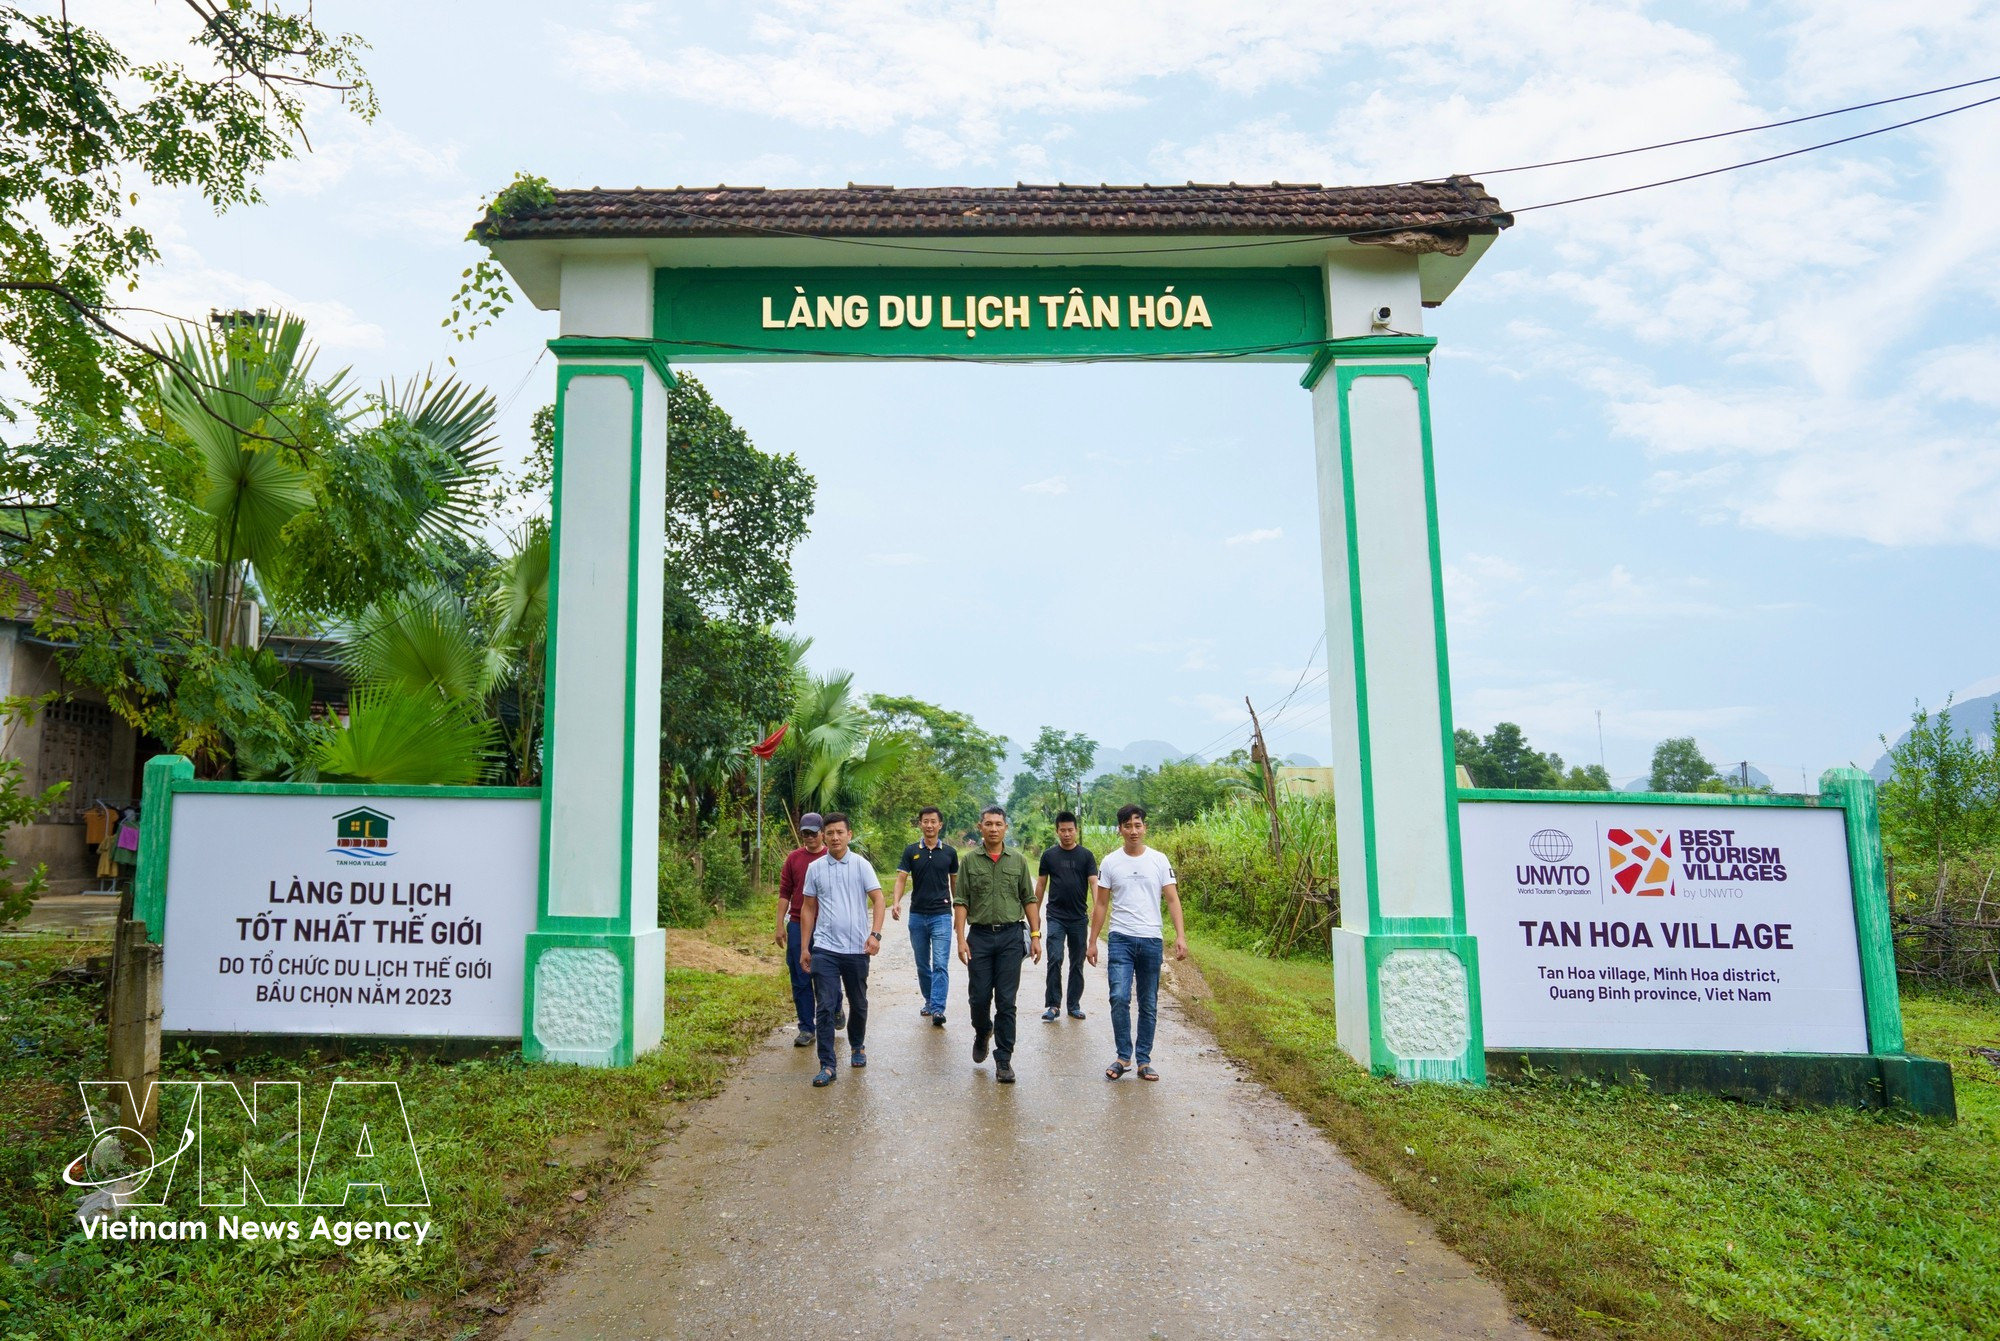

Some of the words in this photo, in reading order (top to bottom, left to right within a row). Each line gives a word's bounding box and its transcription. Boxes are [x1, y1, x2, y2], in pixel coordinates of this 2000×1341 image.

[761, 286, 869, 329] LÀNG
[879, 295, 933, 329] DU
[941, 295, 1031, 338] LỊCH
[1038, 287, 1120, 329] TÂN
[1129, 285, 1214, 329] HÓA
[1679, 829, 1735, 847] BEST
[1680, 846, 1781, 864] TOURISM
[1516, 865, 1590, 886] UNWTO
[1682, 863, 1788, 882] VILLAGES
[268, 875, 343, 904] LÀNG
[350, 882, 385, 905] DU
[392, 883, 451, 913] LỊCH
[1557, 888, 1592, 896] Organization
[1683, 888, 1696, 900] by
[1699, 888, 1744, 899] UNWTO
[236, 911, 287, 942] TỐT
[293, 912, 366, 943] NHẤT
[373, 913, 424, 944] THẾ
[430, 916, 482, 945] GIỚI
[1519, 921, 1583, 948] TAN
[1590, 921, 1654, 949] HOA
[1660, 922, 1794, 950] VILLAGE
[219, 957, 244, 975] DO
[250, 950, 274, 975] TỔ
[278, 954, 330, 976] CHỨC
[334, 959, 360, 977] DU
[365, 960, 408, 982] LỊCH
[413, 956, 452, 979] THẾ
[455, 958, 492, 980] GIỚI
[1537, 966, 1564, 980] Tan
[1567, 966, 1596, 980] Hoa
[1598, 966, 1650, 984] village,
[1653, 967, 1688, 981] Minh
[1691, 968, 1720, 982] Hoa
[1722, 968, 1781, 984] district,
[256, 978, 295, 1003] BẦU
[300, 986, 352, 1008] CHỌN
[358, 984, 400, 1005] NĂM
[405, 988, 452, 1006] 2023
[1549, 985, 1595, 1003] Quang
[1598, 986, 1631, 1000] Binh
[1634, 986, 1701, 1003] province,
[1704, 987, 1734, 1002] Viet
[1738, 988, 1772, 1002] Nam
